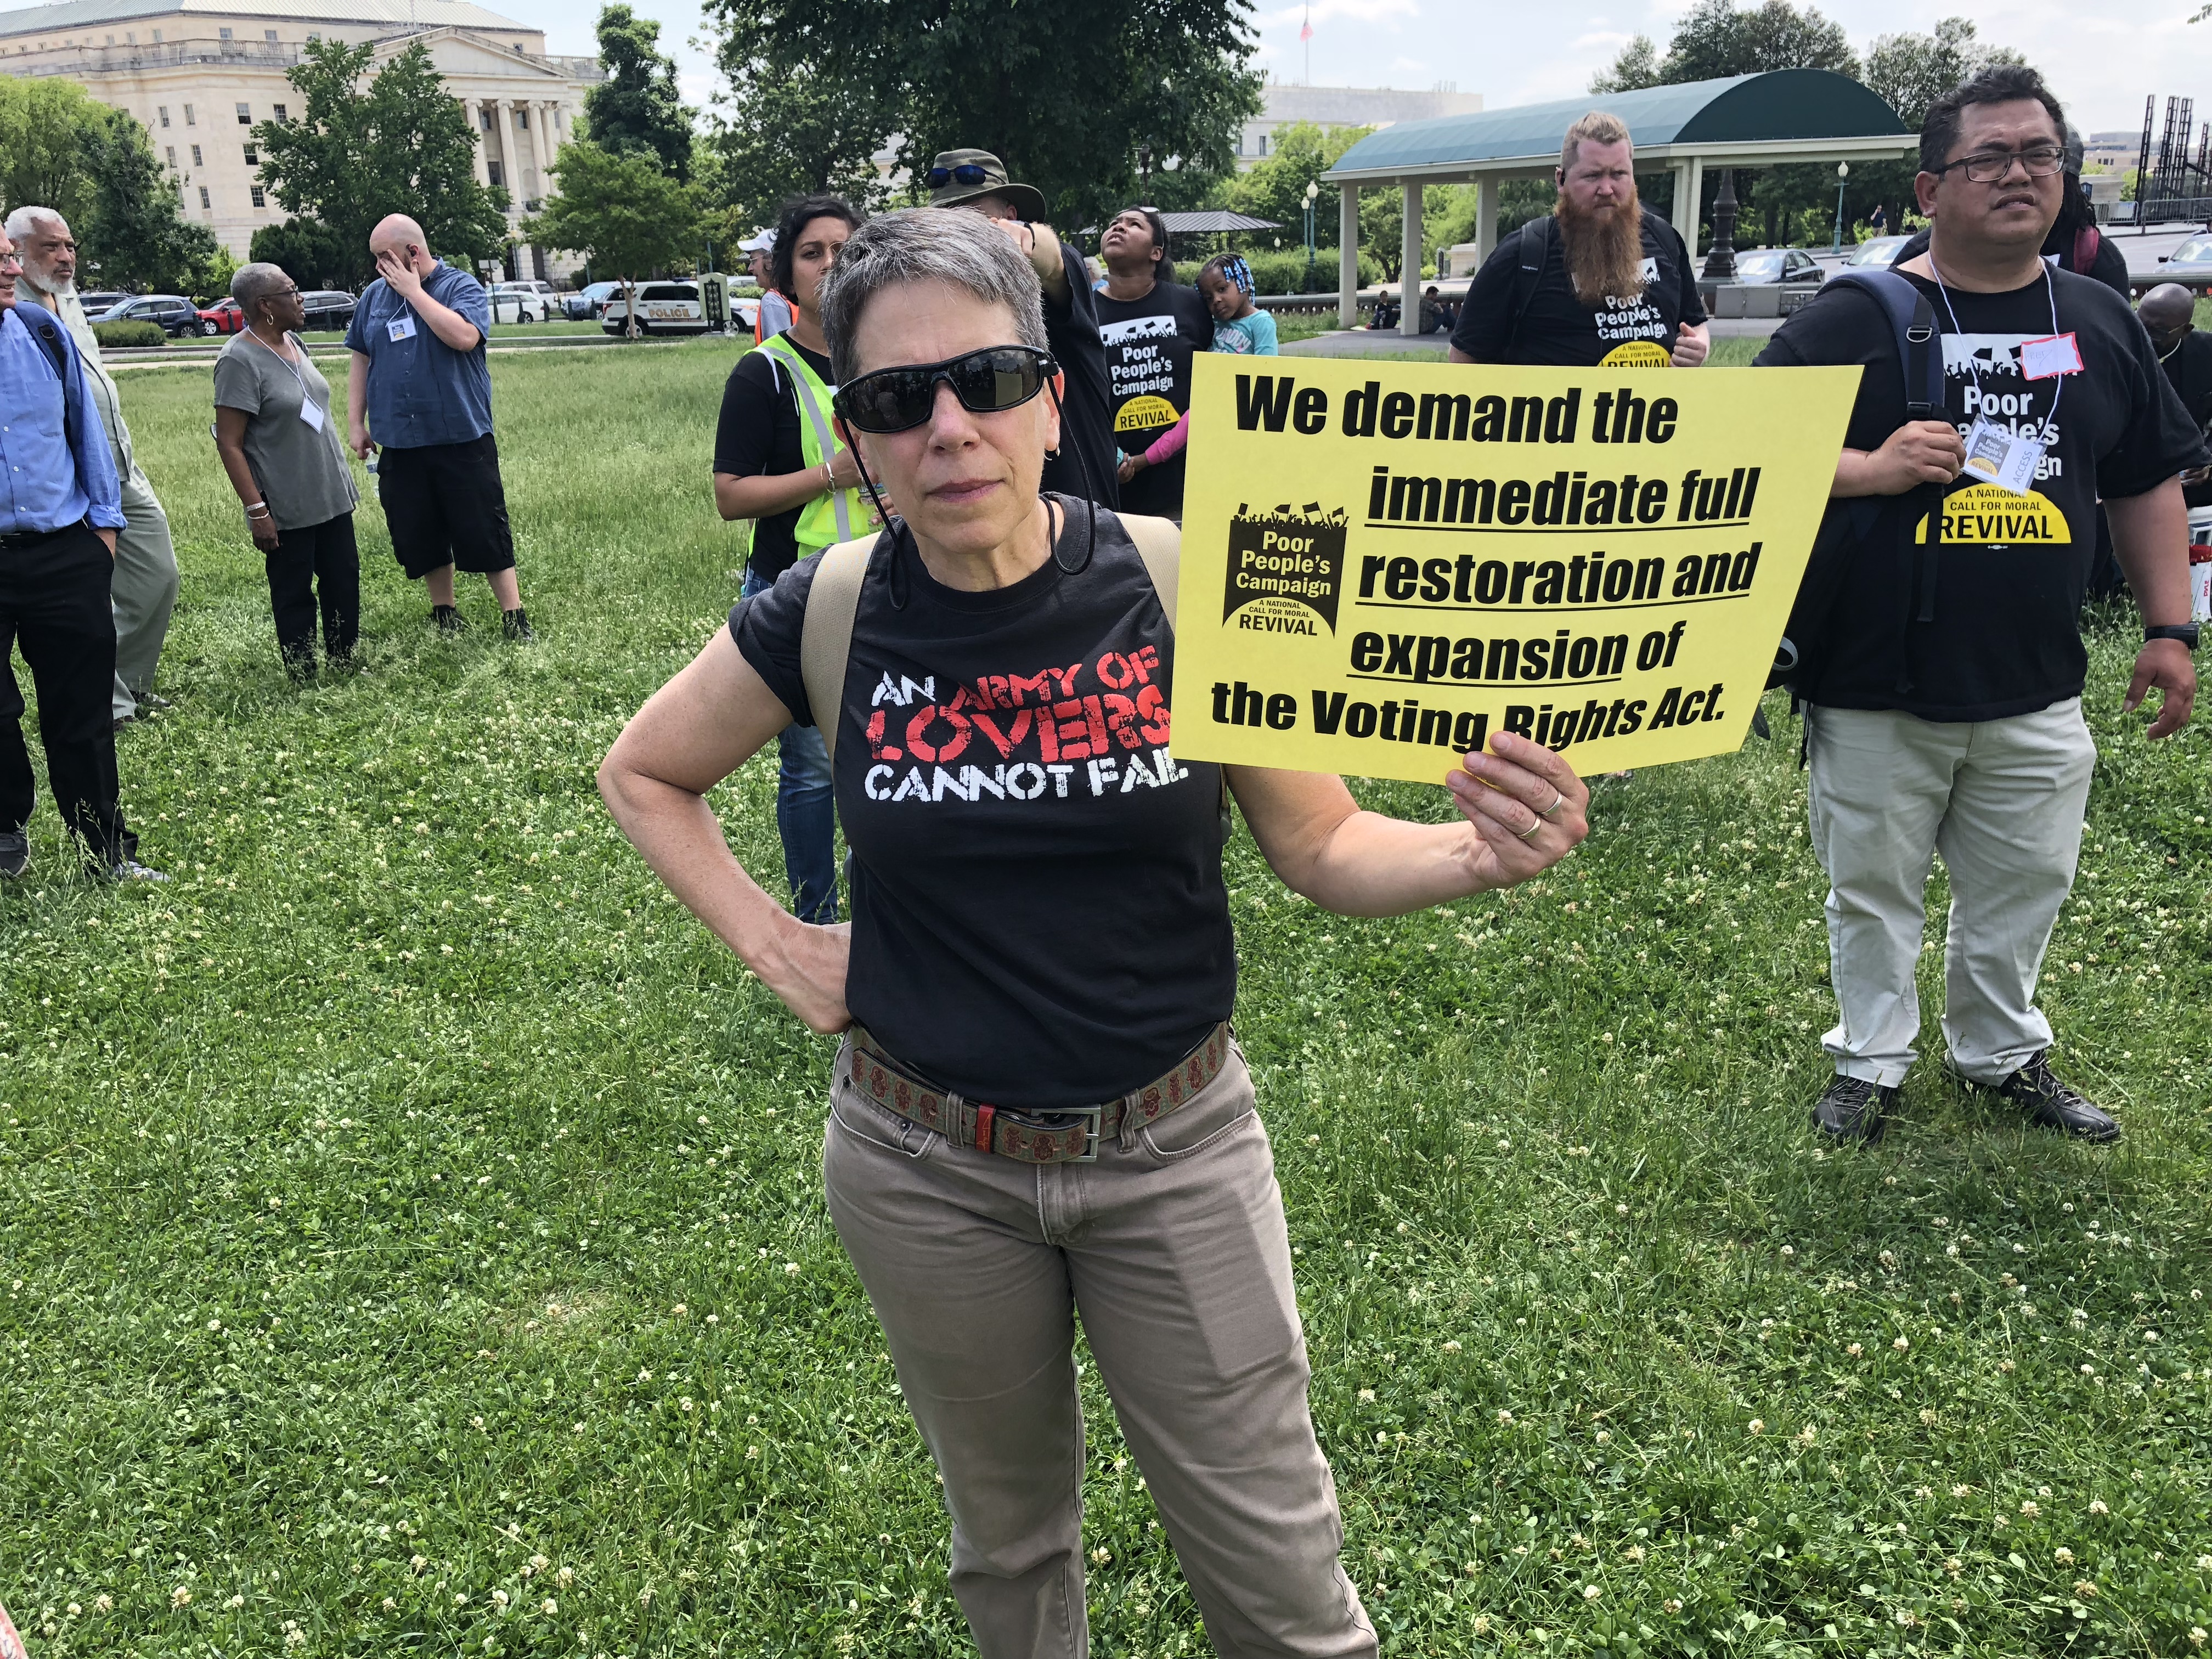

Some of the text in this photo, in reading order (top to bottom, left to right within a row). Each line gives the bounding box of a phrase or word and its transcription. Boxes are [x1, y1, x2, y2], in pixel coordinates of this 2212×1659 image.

[1605, 292, 1643, 309] Poor
[648, 308, 690, 318] POLICE
[1595, 304, 1661, 328] People's
[1598, 321, 1667, 340] Campaign
[1122, 345, 1158, 362] Poor
[1110, 357, 1173, 381] People's
[1113, 375, 1173, 396] Campaign
[1235, 374, 1678, 443] We demand the
[1964, 385, 2033, 416] Poor
[1120, 410, 1171, 428] REVIVAL
[1975, 448, 2002, 464] Campaign
[1985, 438, 2001, 450] Poor
[2012, 450, 2033, 485] ACCESS
[1368, 466, 1762, 526] immediate full
[1966, 489, 1972, 498] A
[1950, 502, 2041, 511] CALL FOR MORAL
[1941, 515, 2053, 539] REVIVAL
[1262, 531, 1314, 553] Poor
[1241, 550, 1330, 575] People's
[1358, 542, 1763, 604] restoration and
[1236, 572, 1331, 598] Campaign
[1266, 600, 1301, 609] NATIONAL
[1284, 610, 1310, 618] MORAL
[1239, 614, 1318, 636] REVIVAL
[1350, 620, 1687, 683] expansion of
[871, 645, 1159, 710] AN ARMY OF
[866, 684, 1171, 763] LOVERS
[1211, 681, 1725, 754] the Voting Rights Act.
[865, 746, 1189, 802] CANNOT FAIL
